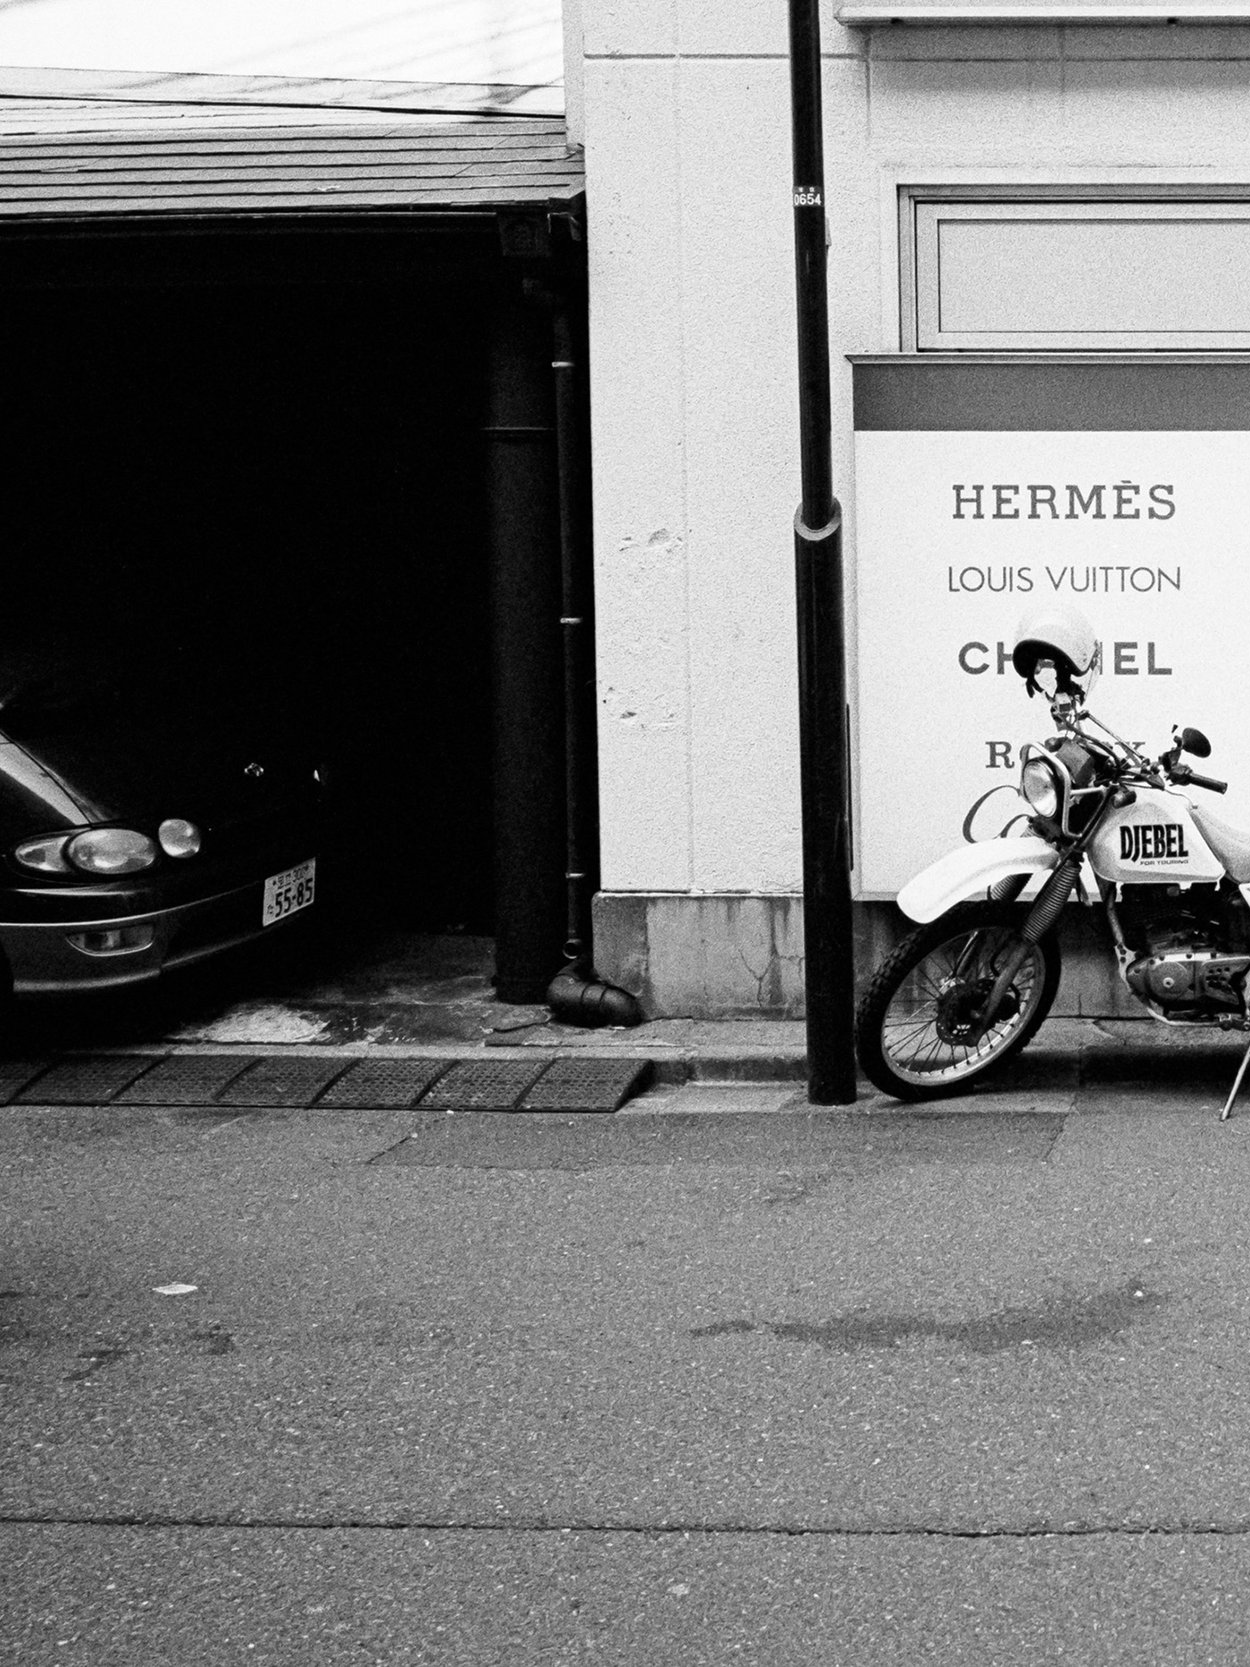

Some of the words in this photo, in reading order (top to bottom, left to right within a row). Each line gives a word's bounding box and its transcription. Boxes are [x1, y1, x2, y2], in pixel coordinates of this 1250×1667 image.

[794, 193, 822, 206] 0654
[952, 480, 1176, 520] HERMÈS
[948, 566, 1034, 592] LOUIS
[1045, 566, 1181, 592] VUITTON
[958, 641, 1173, 675] CHEL
[1119, 823, 1189, 863] DJEBEL
